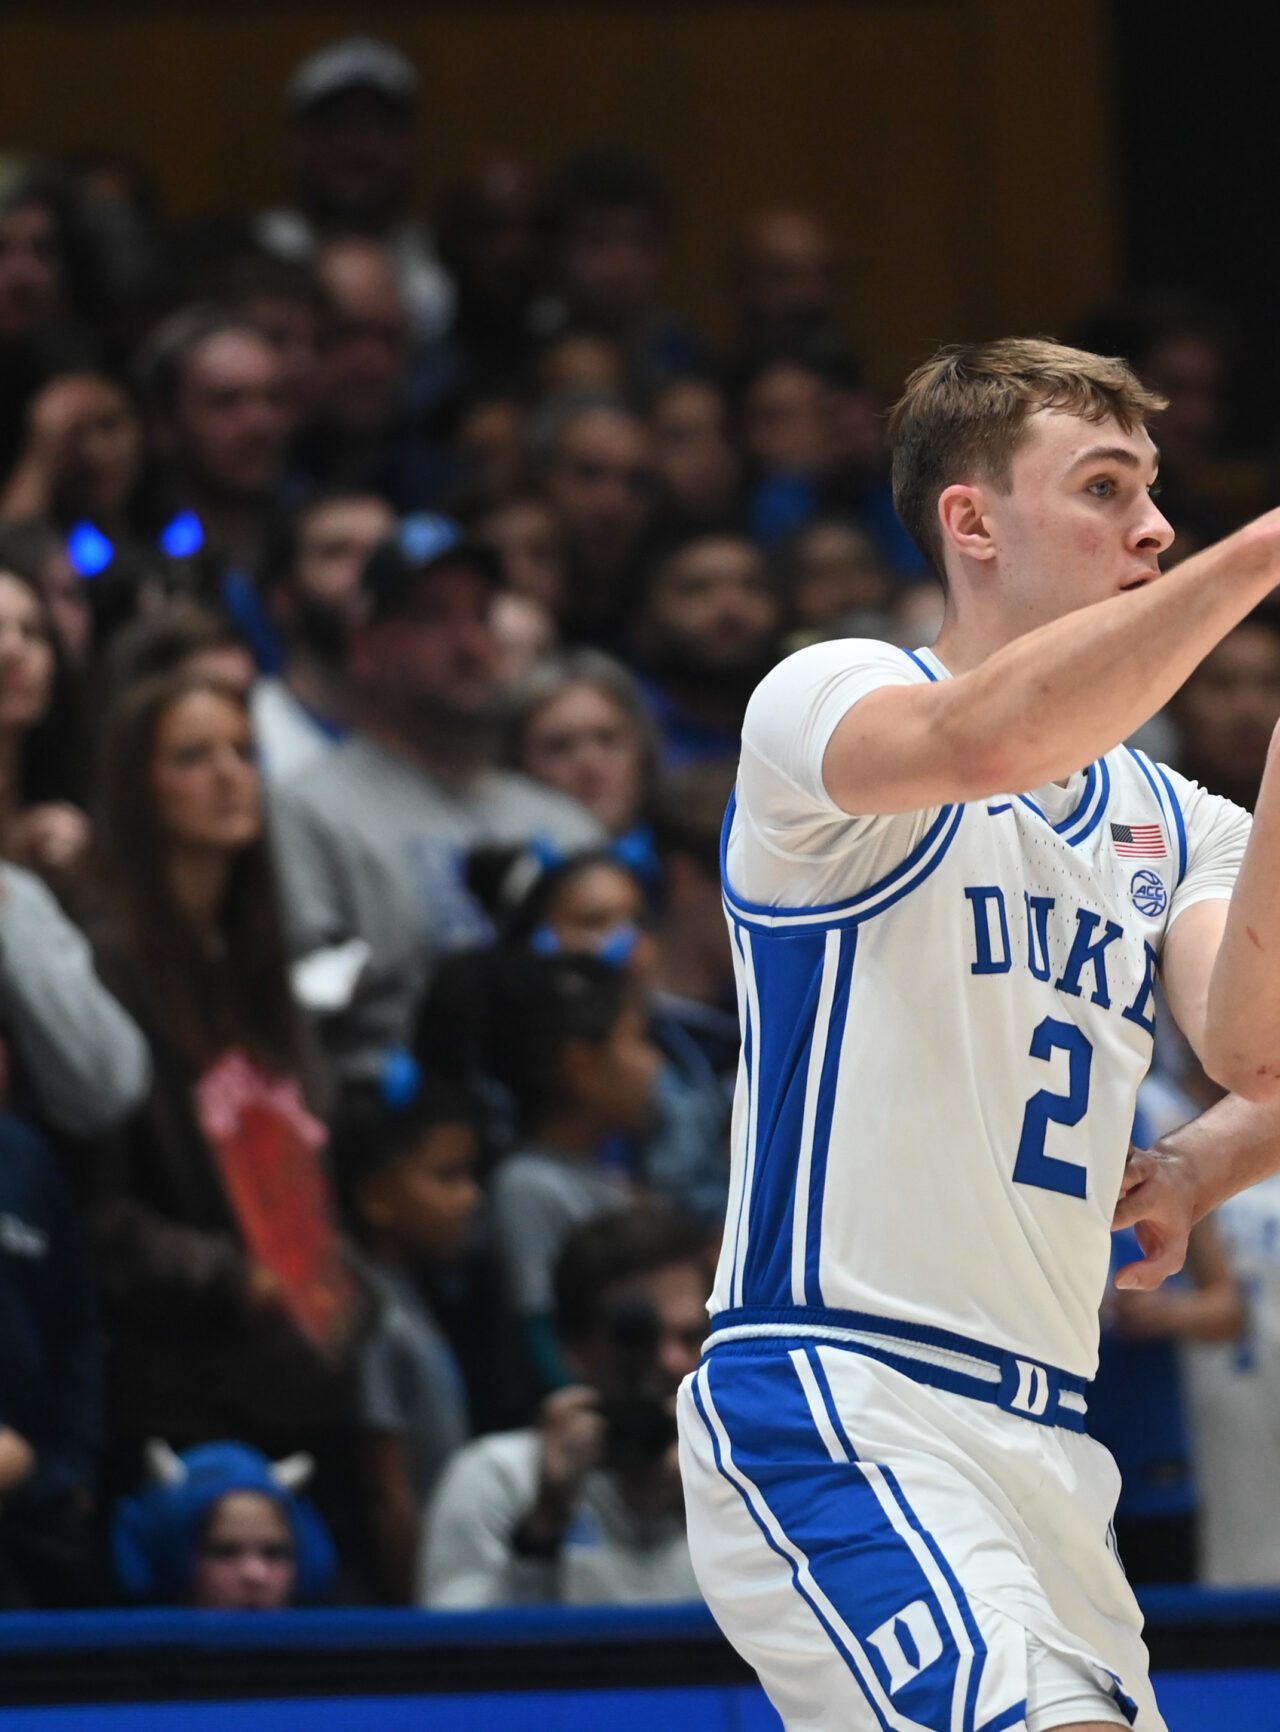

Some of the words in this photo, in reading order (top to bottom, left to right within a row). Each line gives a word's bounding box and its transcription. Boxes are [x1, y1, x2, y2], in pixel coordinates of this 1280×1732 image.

[1135, 885, 1164, 898] ACC
[1012, 1015, 1094, 1200] 2
[1010, 1359, 1050, 1417] D
[866, 1599, 944, 1695] D
